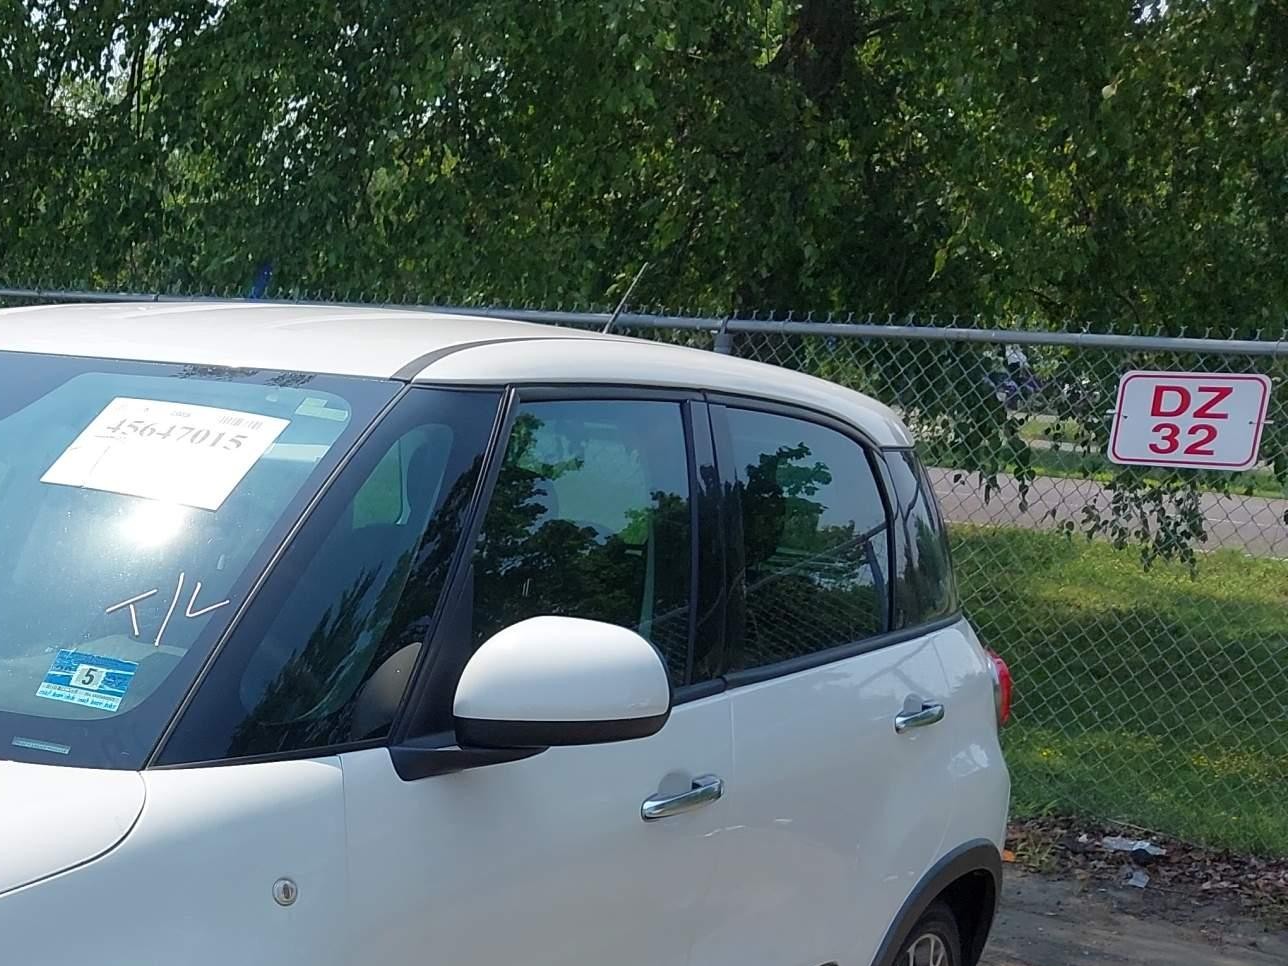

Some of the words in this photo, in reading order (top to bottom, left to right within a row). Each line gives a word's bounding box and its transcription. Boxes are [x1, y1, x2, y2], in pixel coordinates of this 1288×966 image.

[1150, 384, 1234, 419] DZ
[106, 418, 249, 451] 45647015
[1148, 423, 1218, 456] 32
[81, 667, 98, 686] 5
